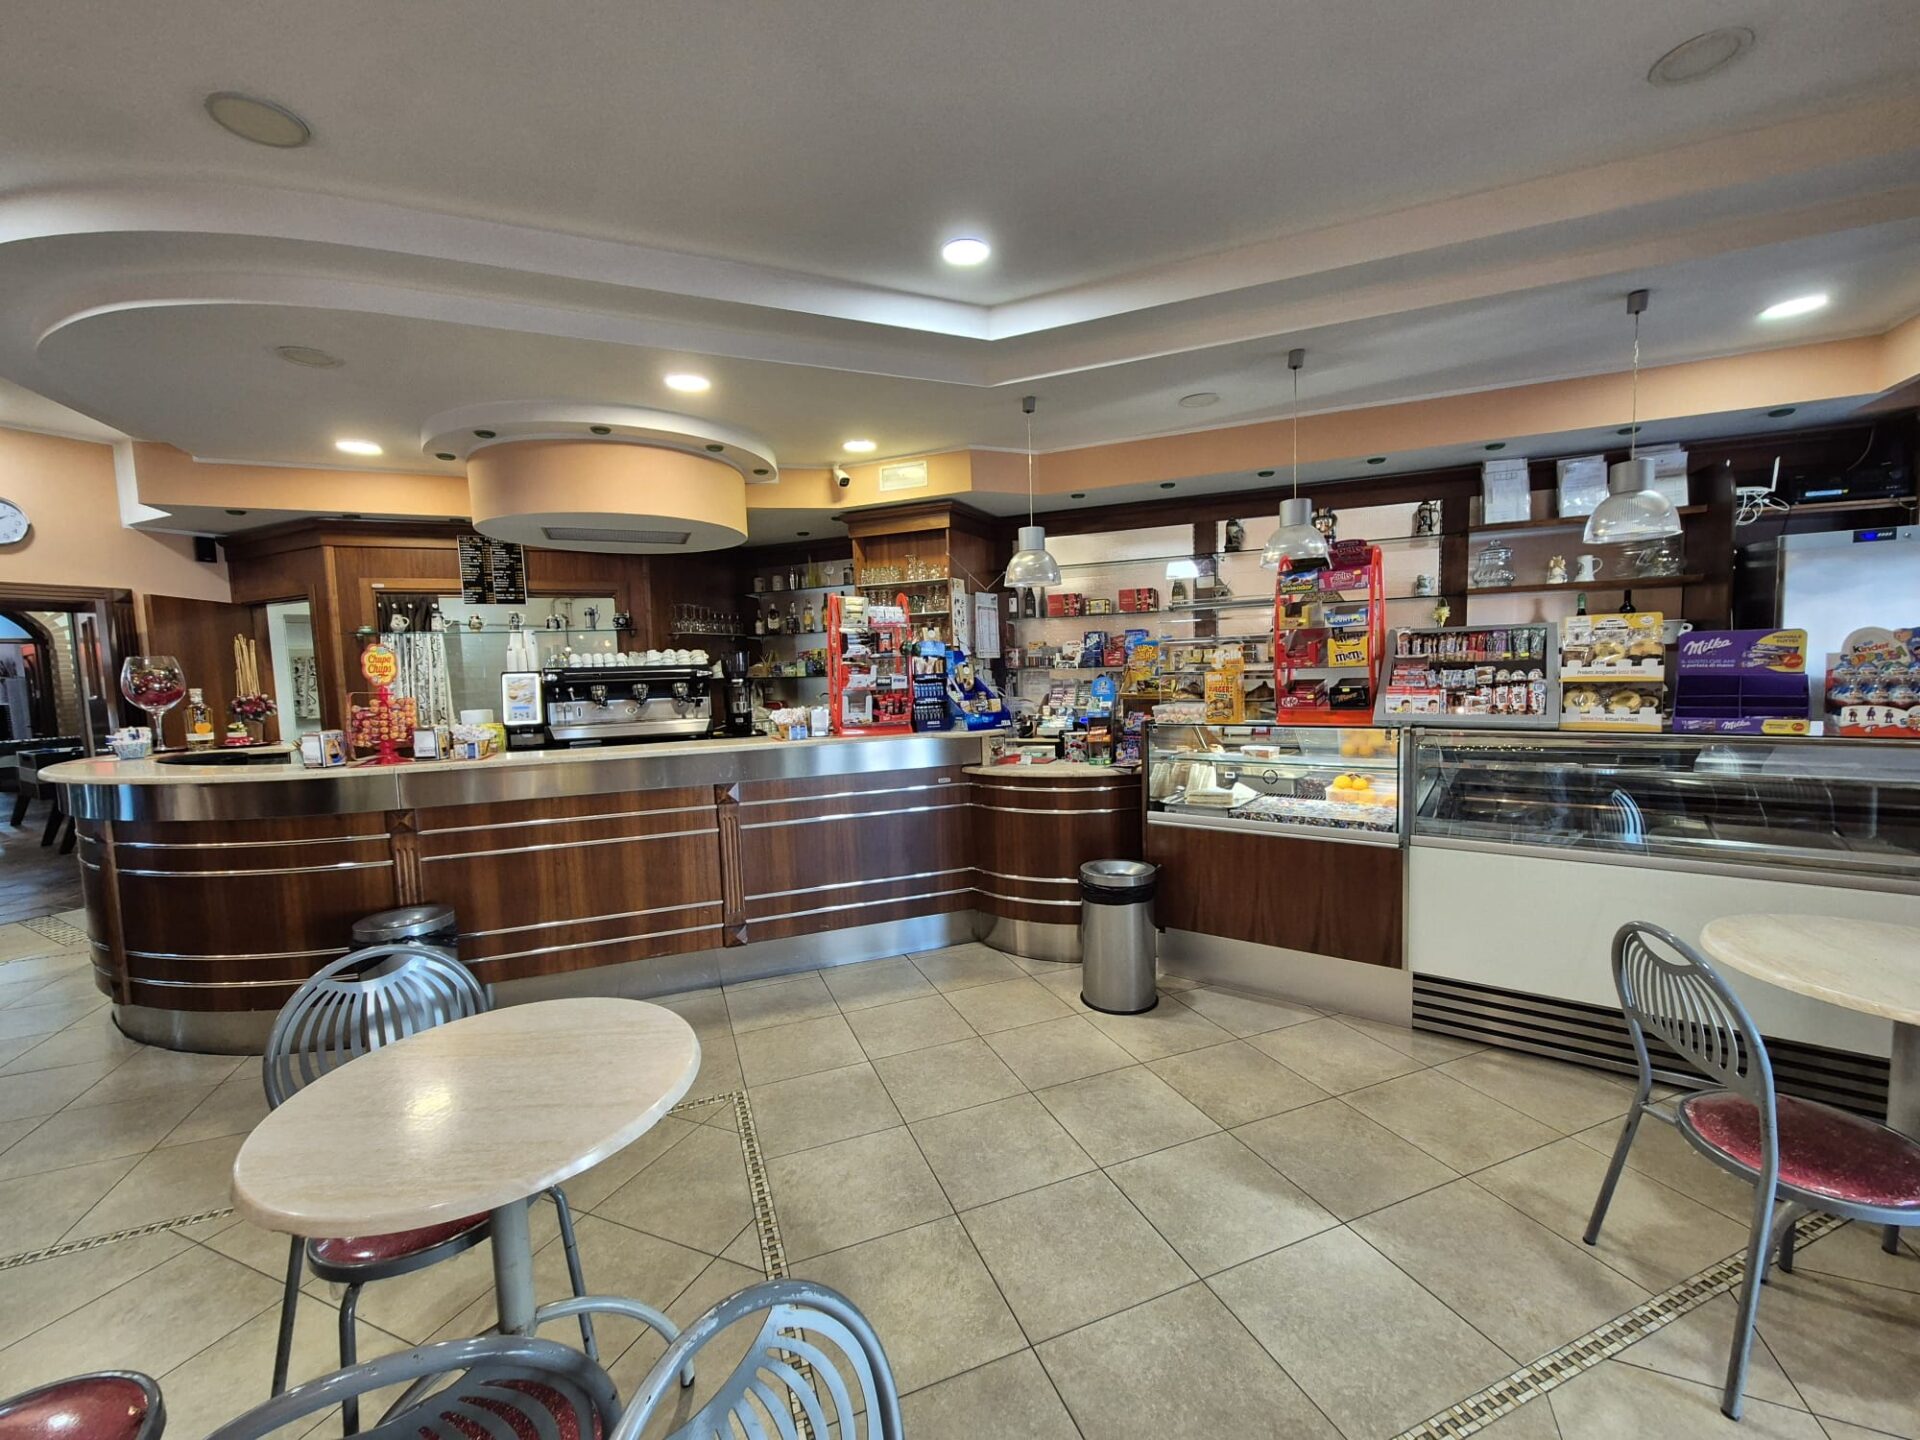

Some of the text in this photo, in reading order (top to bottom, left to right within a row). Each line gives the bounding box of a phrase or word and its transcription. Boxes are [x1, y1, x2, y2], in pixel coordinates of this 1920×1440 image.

[1683, 637, 1734, 655] Milka
[1853, 642, 1890, 654] Kinder
[367, 654, 392, 665] Chupa
[367, 664, 392, 675] Chups
[1721, 720, 1752, 730] Milka
